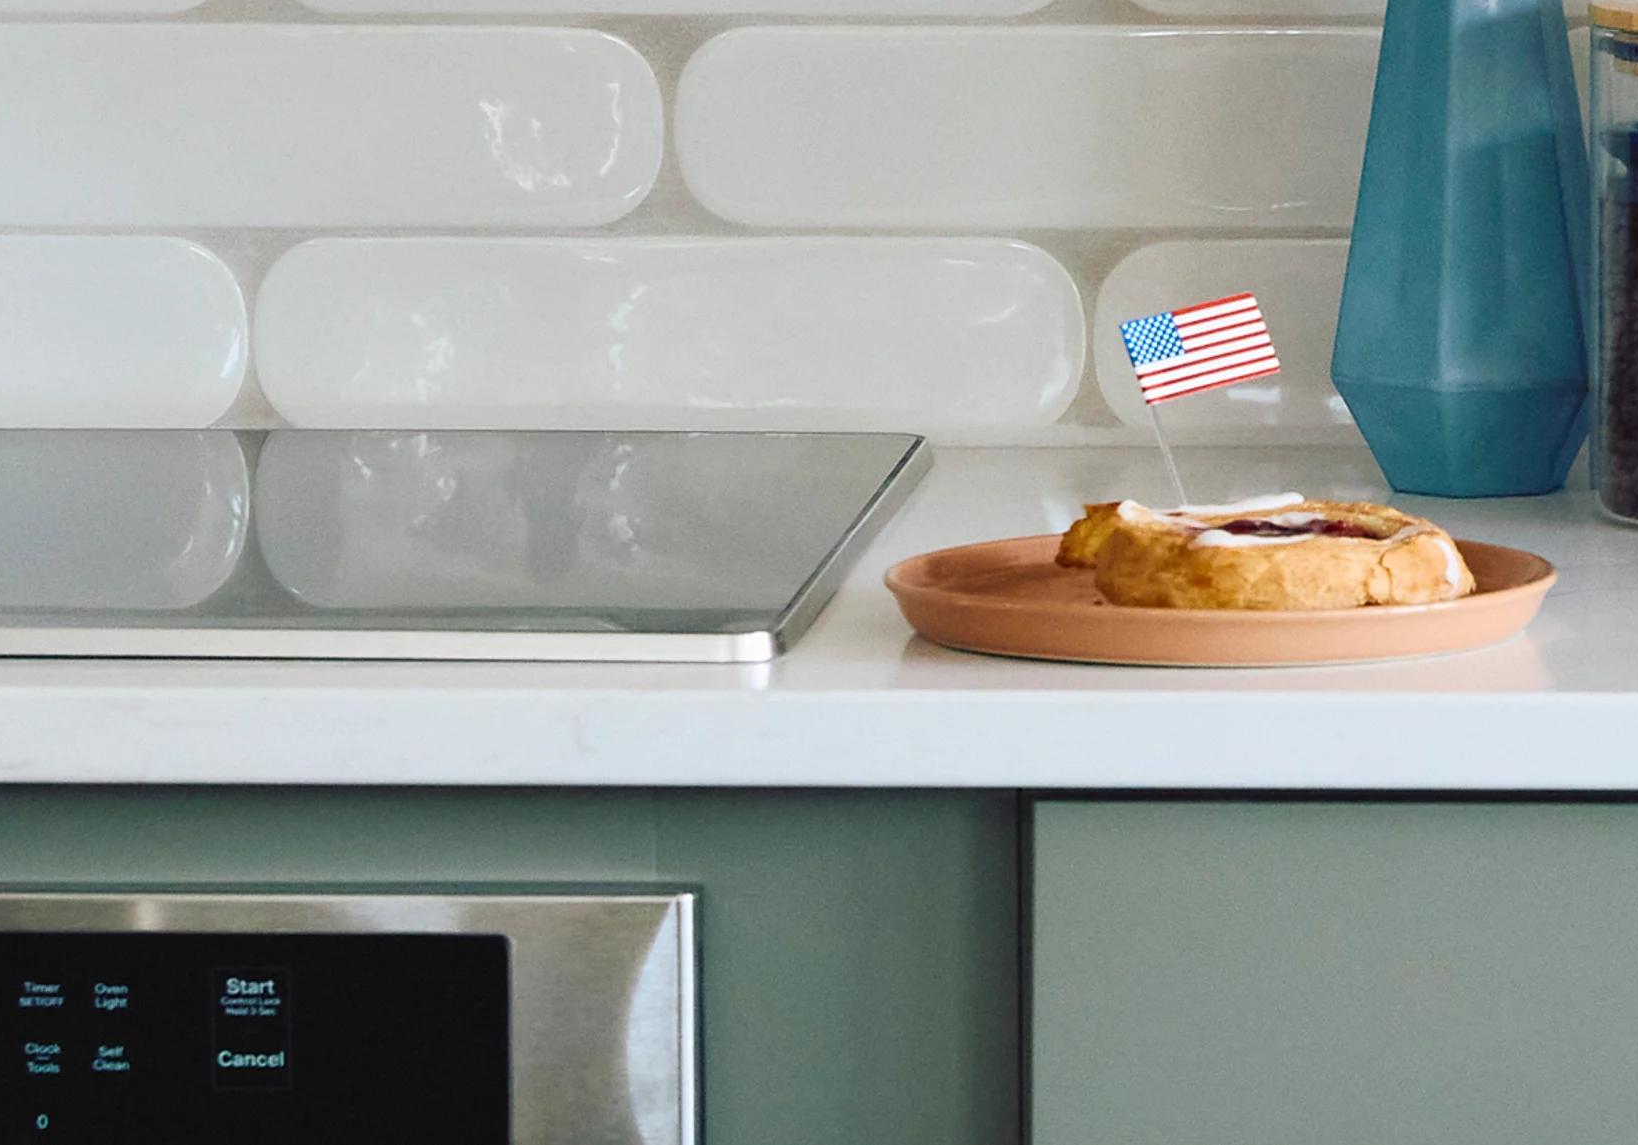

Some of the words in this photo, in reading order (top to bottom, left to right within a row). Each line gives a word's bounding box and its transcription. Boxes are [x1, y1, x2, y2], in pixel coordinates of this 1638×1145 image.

[24, 982, 60, 993] Timer
[94, 983, 128, 995] Oven
[226, 978, 274, 995] Start
[94, 997, 127, 1010] Light
[24, 1043, 61, 1054] Clock
[98, 1046, 124, 1058] Self
[92, 1058, 130, 1071] Clean
[217, 1050, 284, 1067] Cancel
[27, 1061, 60, 1073] Tools
[36, 1114, 48, 1129] 0
